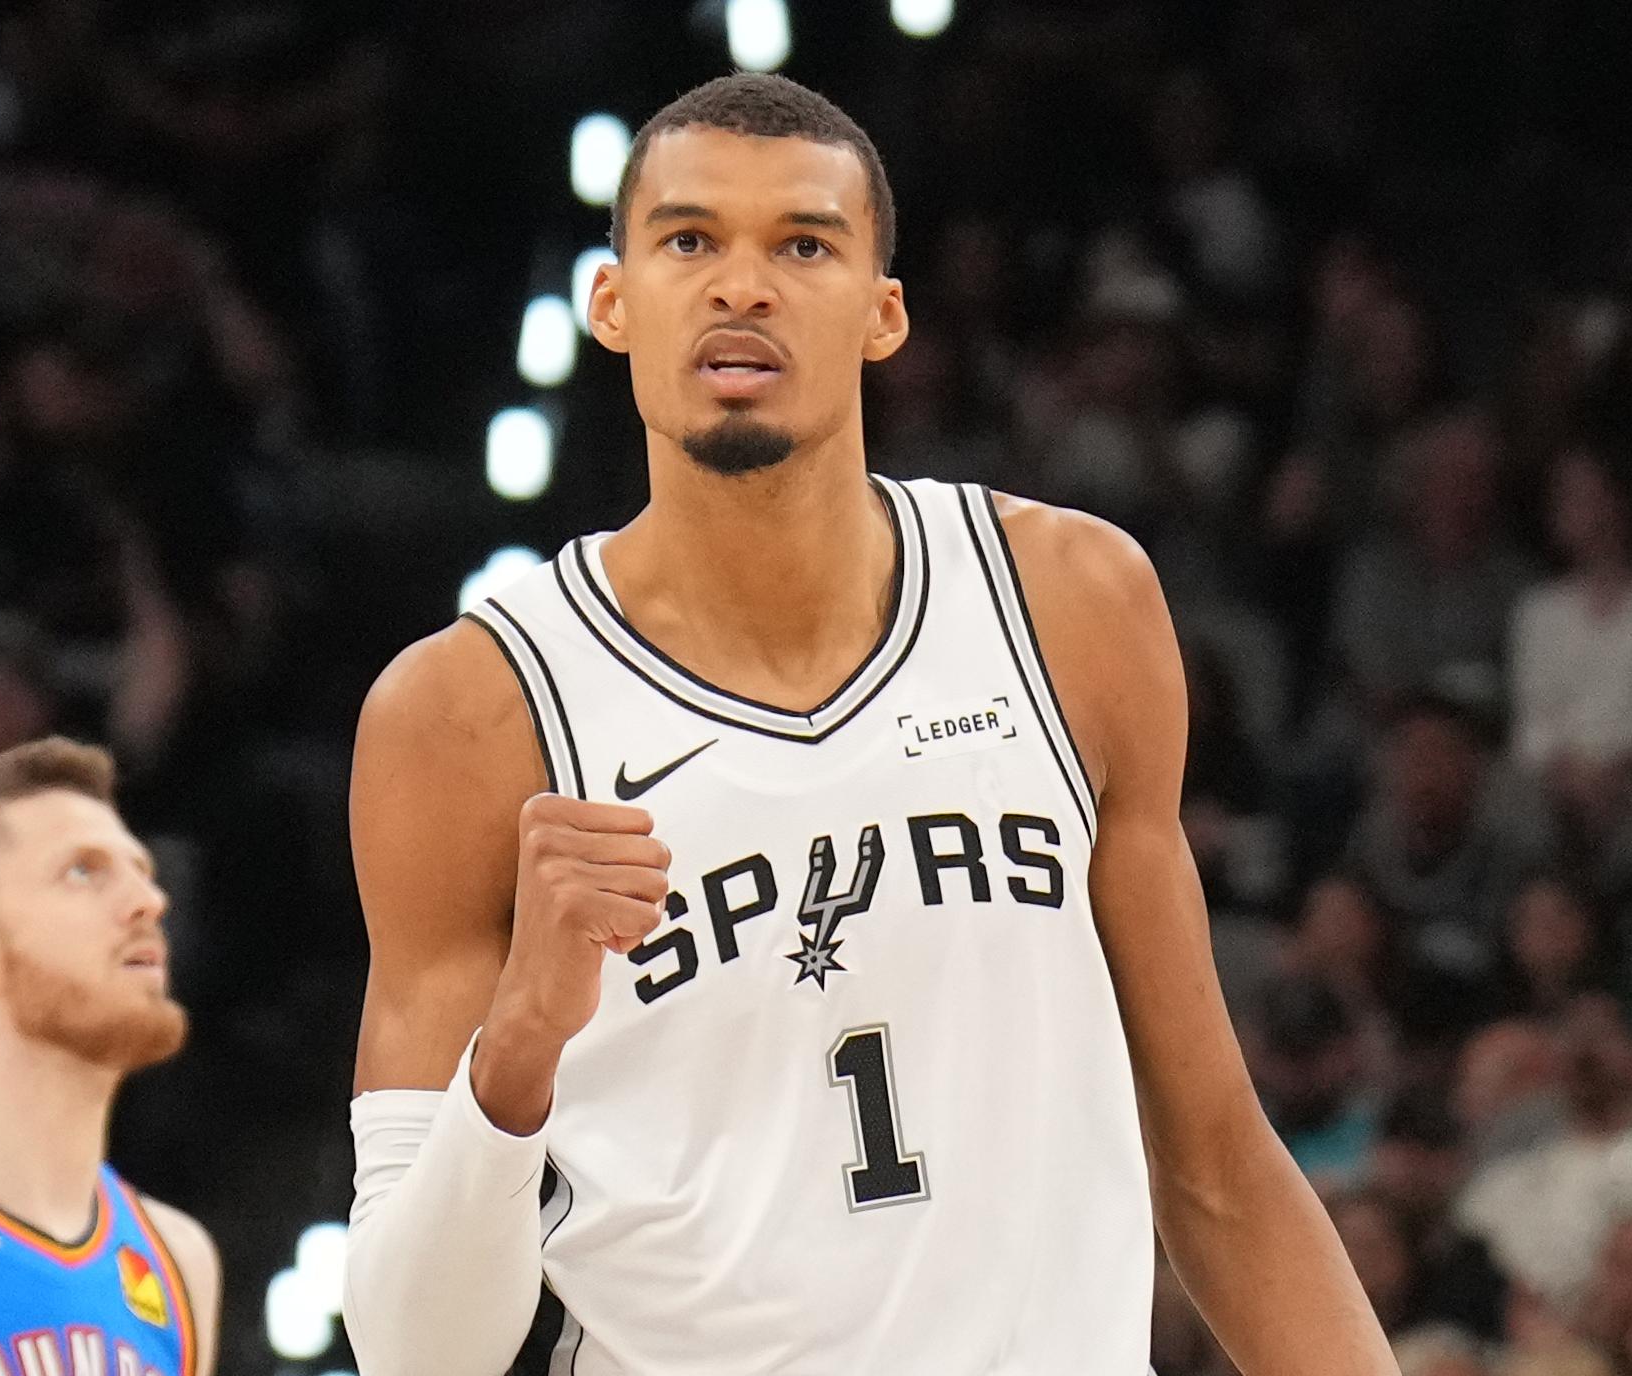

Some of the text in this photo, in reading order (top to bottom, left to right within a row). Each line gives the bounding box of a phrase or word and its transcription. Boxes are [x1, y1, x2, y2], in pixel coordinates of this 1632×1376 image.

[915, 711, 1000, 743] LEDGER
[626, 812, 1064, 1005] SPURS
[825, 1021, 931, 1213] 1
